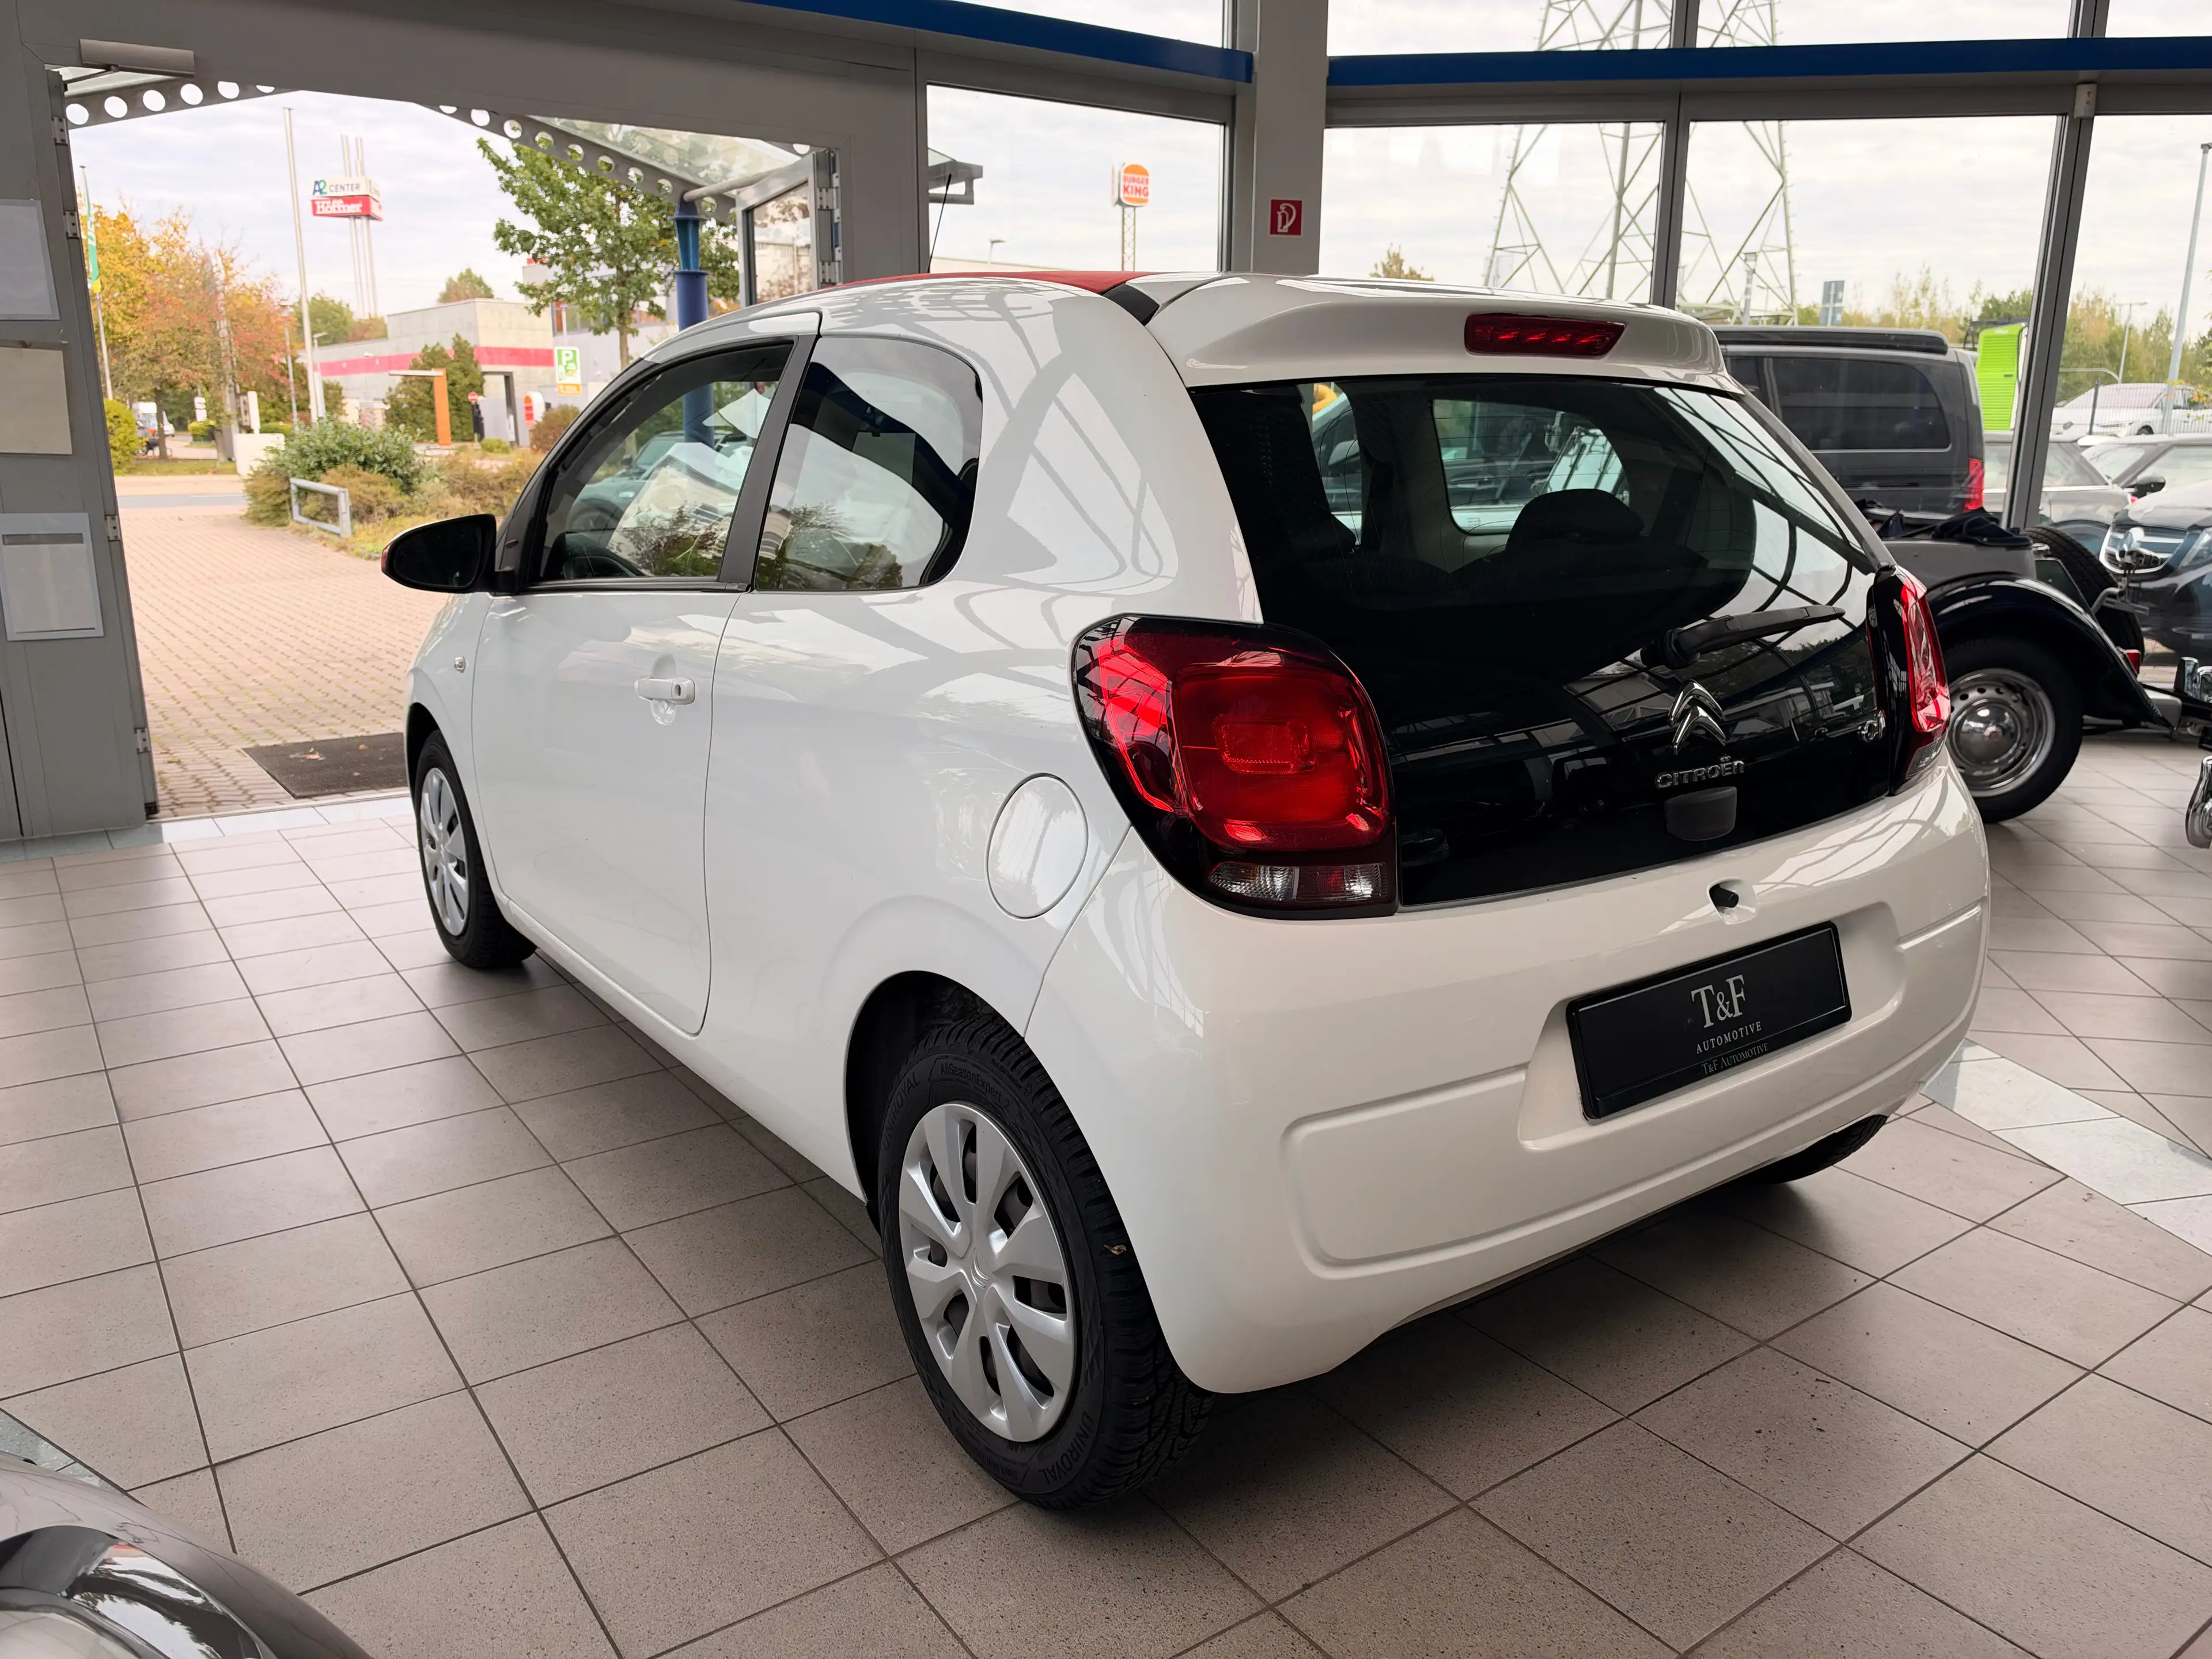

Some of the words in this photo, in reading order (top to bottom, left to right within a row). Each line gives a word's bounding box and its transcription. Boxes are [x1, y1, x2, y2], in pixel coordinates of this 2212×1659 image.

[313, 180, 327, 195] A2
[329, 183, 361, 193] CENTER
[1124, 176, 1149, 184] BURGER
[1124, 184, 1149, 197] KING
[561, 350, 573, 366] P
[1691, 974, 1745, 1028] T&F
[1696, 1021, 1762, 1054] AUTOMOTIVE
[1701, 1059, 1718, 1074] T&F
[940, 1062, 1002, 1104] AllSeasonExpert
[882, 1072, 921, 1150] UNIROYAL
[1038, 1410, 1094, 1485] UNIROYAL
